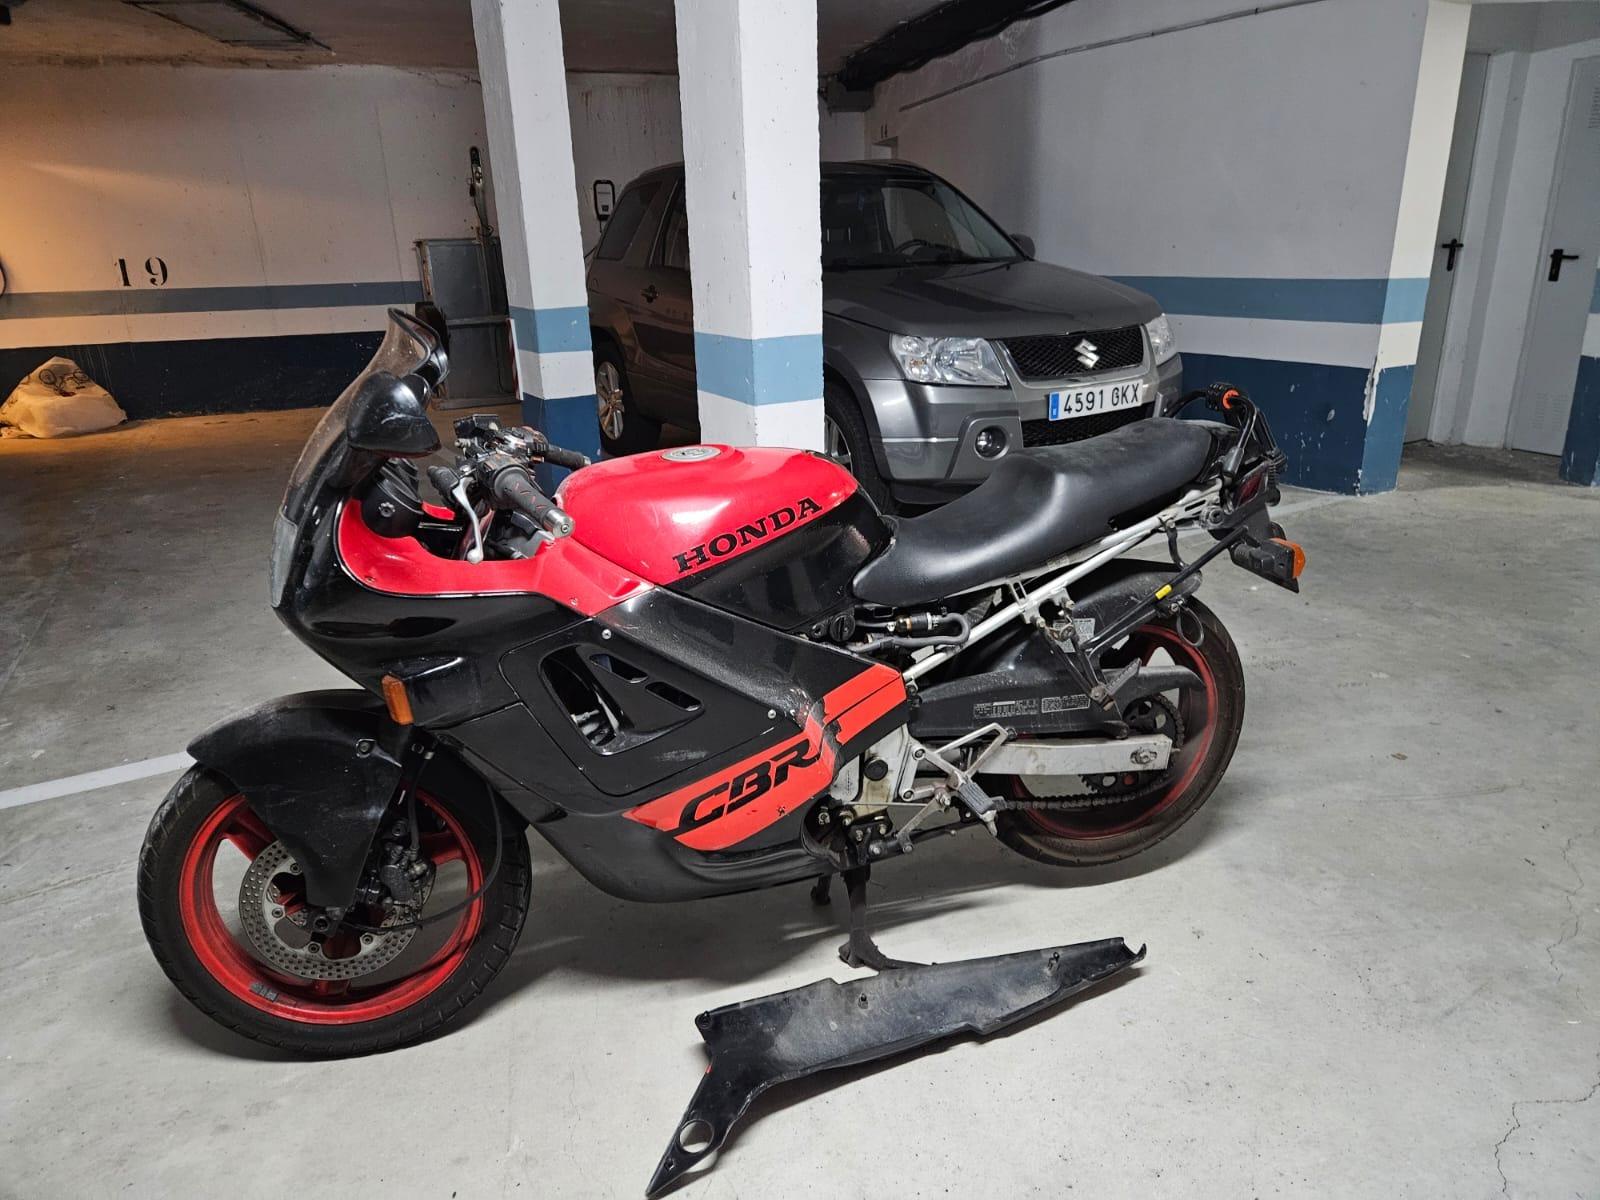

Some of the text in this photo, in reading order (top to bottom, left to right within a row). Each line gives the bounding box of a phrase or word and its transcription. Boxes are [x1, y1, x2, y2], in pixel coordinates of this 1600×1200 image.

[114, 256, 168, 287] 19
[1063, 383, 1140, 414] 4591 GKX
[672, 497, 823, 574] HONDA
[679, 738, 821, 830] CBR
